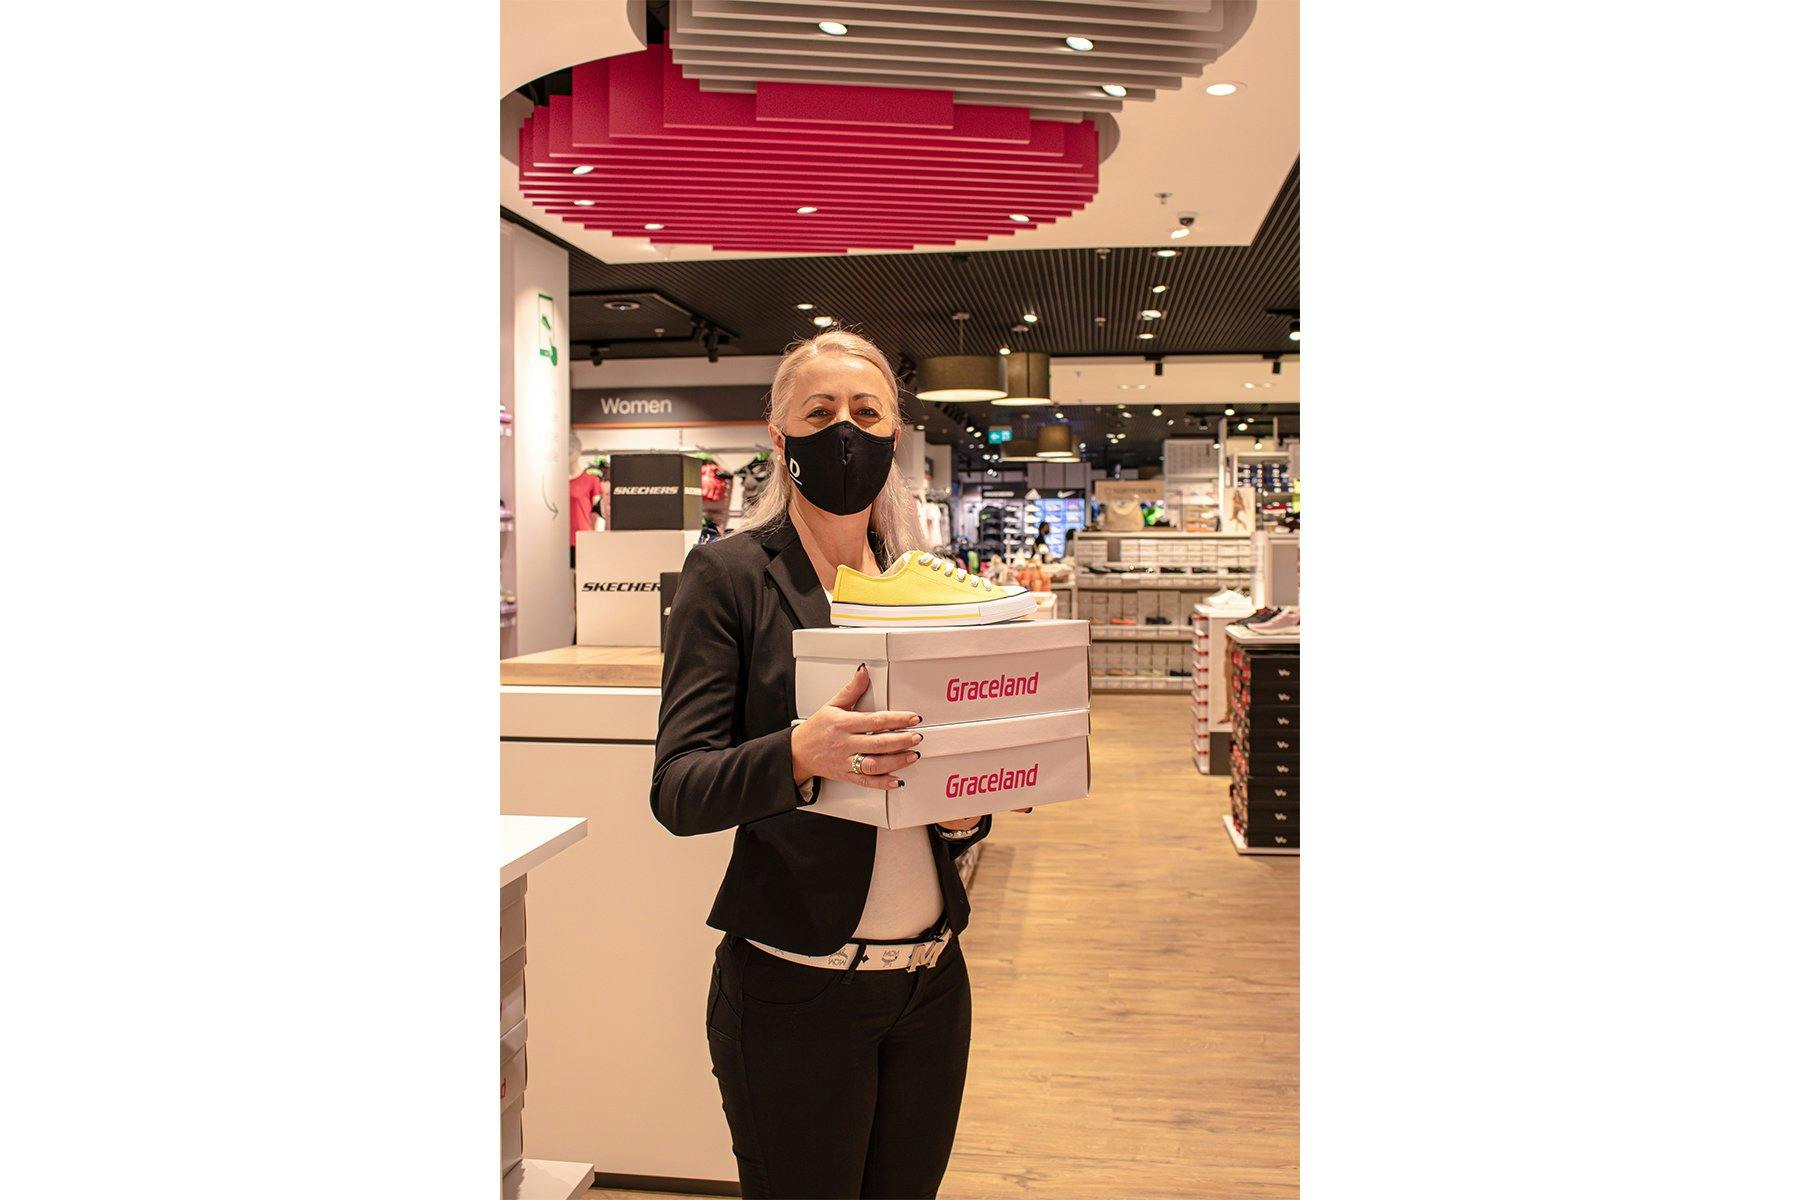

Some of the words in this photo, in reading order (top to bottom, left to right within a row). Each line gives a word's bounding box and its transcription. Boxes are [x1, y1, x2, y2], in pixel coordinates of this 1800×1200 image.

[600, 397, 673, 415] Women
[613, 486, 679, 495] SKECHERS
[946, 672, 1039, 703] Graceland
[945, 764, 1039, 799] Graceland
